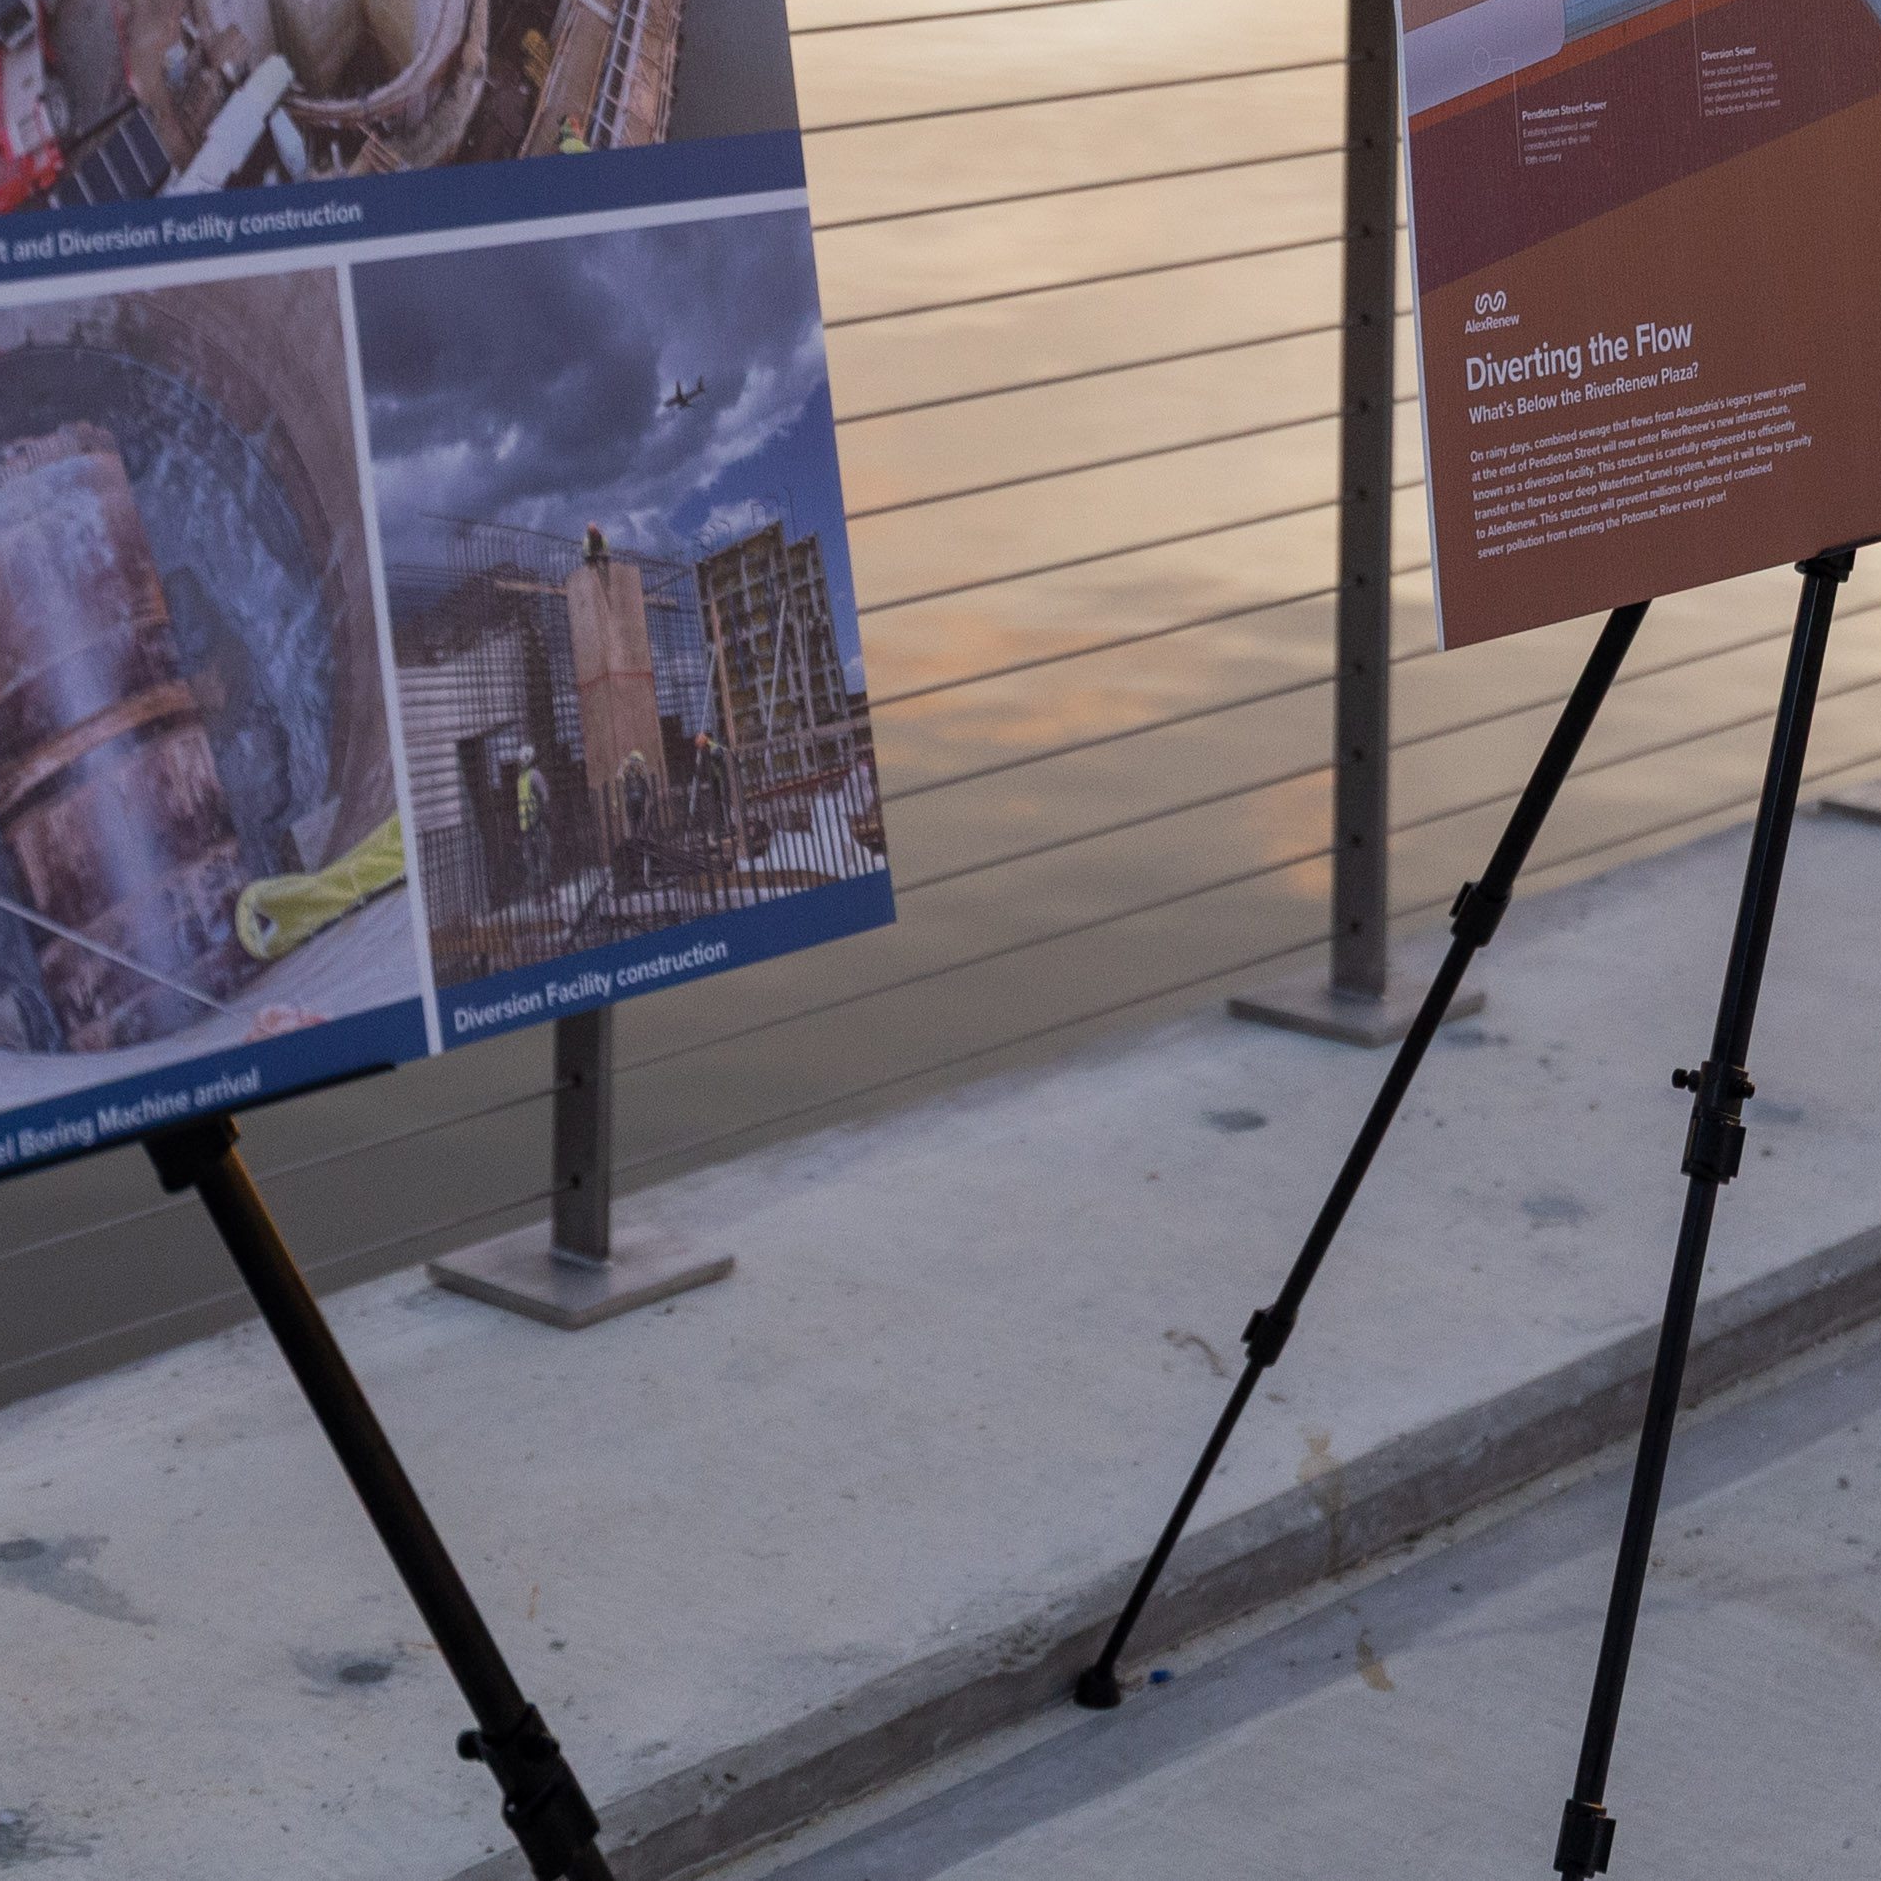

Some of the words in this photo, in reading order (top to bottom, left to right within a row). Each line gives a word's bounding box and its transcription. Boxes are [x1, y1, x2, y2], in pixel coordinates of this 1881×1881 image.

[1522, 109, 1559, 121] Pendleton
[1561, 105, 1583, 115] Street
[1584, 103, 1607, 112] Sewer
[13, 232, 55, 260] and
[59, 226, 159, 254] Diversion
[163, 215, 236, 242] Facility
[241, 204, 362, 233] construction
[1465, 316, 1519, 333] AlexRenew
[1465, 341, 1581, 391] Diverting
[1588, 332, 1629, 366] the
[1635, 322, 1693, 357] Flow
[1469, 401, 1514, 424] What's
[1517, 394, 1557, 414] Below
[1561, 387, 1581, 405] the
[1585, 374, 1658, 401] RiverRenew
[1661, 362, 1699, 384] Plaza?
[1470, 449, 1483, 461] On
[1485, 445, 1507, 458] rainy
[1509, 441, 1532, 453] days,
[1534, 428, 1577, 447] combined
[1578, 423, 1611, 438] sewage
[1612, 418, 1629, 430] that
[1631, 414, 1653, 427] flows
[1654, 410, 1674, 421] from
[1726, 393, 1752, 407] legacy
[1753, 388, 1776, 400] sewer
[1778, 381, 1806, 397] system
[1472, 470, 1480, 481] at
[1482, 467, 1497, 479] the
[1499, 461, 1516, 475] end
[1518, 459, 1527, 471] of
[1529, 452, 1572, 469] Pendleton
[1574, 444, 1600, 459] Street
[1602, 439, 1616, 453] will
[1618, 438, 1635, 449] now
[1637, 433, 1659, 445] enter
[1717, 417, 1733, 428] new
[1473, 486, 1502, 500] known
[1504, 483, 1515, 493] as
[1517, 482, 1522, 490] a
[1524, 472, 1564, 489] diversion
[1597, 460, 1615, 472] This
[1617, 452, 1653, 468] structure
[1655, 449, 1662, 459] is
[1664, 440, 1699, 457] carefully
[1701, 429, 1746, 450] engineered
[1747, 429, 1755, 439] to
[1757, 419, 1795, 436] efficiently
[1475, 504, 1509, 519] transfer
[1511, 499, 1525, 511] the
[1527, 496, 1546, 508] flow
[1547, 493, 1557, 503] to
[1559, 490, 1573, 501] our
[1575, 485, 1597, 497] deep
[1599, 472, 1643, 491] Waterfront
[1645, 465, 1672, 481] Tunnel
[1706, 454, 1731, 467] where
[1733, 451, 1738, 461] it
[1740, 446, 1754, 459] will
[1755, 445, 1772, 456] flow
[1774, 441, 1783, 454] by
[1785, 435, 1812, 452] gravity
[1476, 529, 1485, 539] to
[1487, 517, 1537, 536] AlexRenew.
[1539, 511, 1558, 524] This
[1560, 503, 1598, 519] structure
[1600, 497, 1614, 510] will
[1616, 490, 1648, 509] prevent
[1650, 484, 1681, 499] millions
[1683, 479, 1691, 491] of
[1693, 475, 1722, 492] gallons
[1724, 470, 1732, 482] of
[1734, 461, 1772, 479] combined
[1478, 544, 1504, 557] sewer
[1506, 535, 1544, 554] pollution
[1546, 529, 1566, 542] from
[1568, 521, 1604, 536] entering
[1606, 516, 1619, 528] the
[1621, 508, 1657, 524] Potomac
[1659, 503, 1680, 515] River
[1682, 497, 1705, 510] every
[453, 991, 543, 1033] Diversion
[547, 972, 613, 1007] Facility
[617, 941, 728, 987] construction
[19, 1119, 94, 1156] Boring
[98, 1093, 190, 1133] Machine
[195, 1068, 261, 1107] arrival
